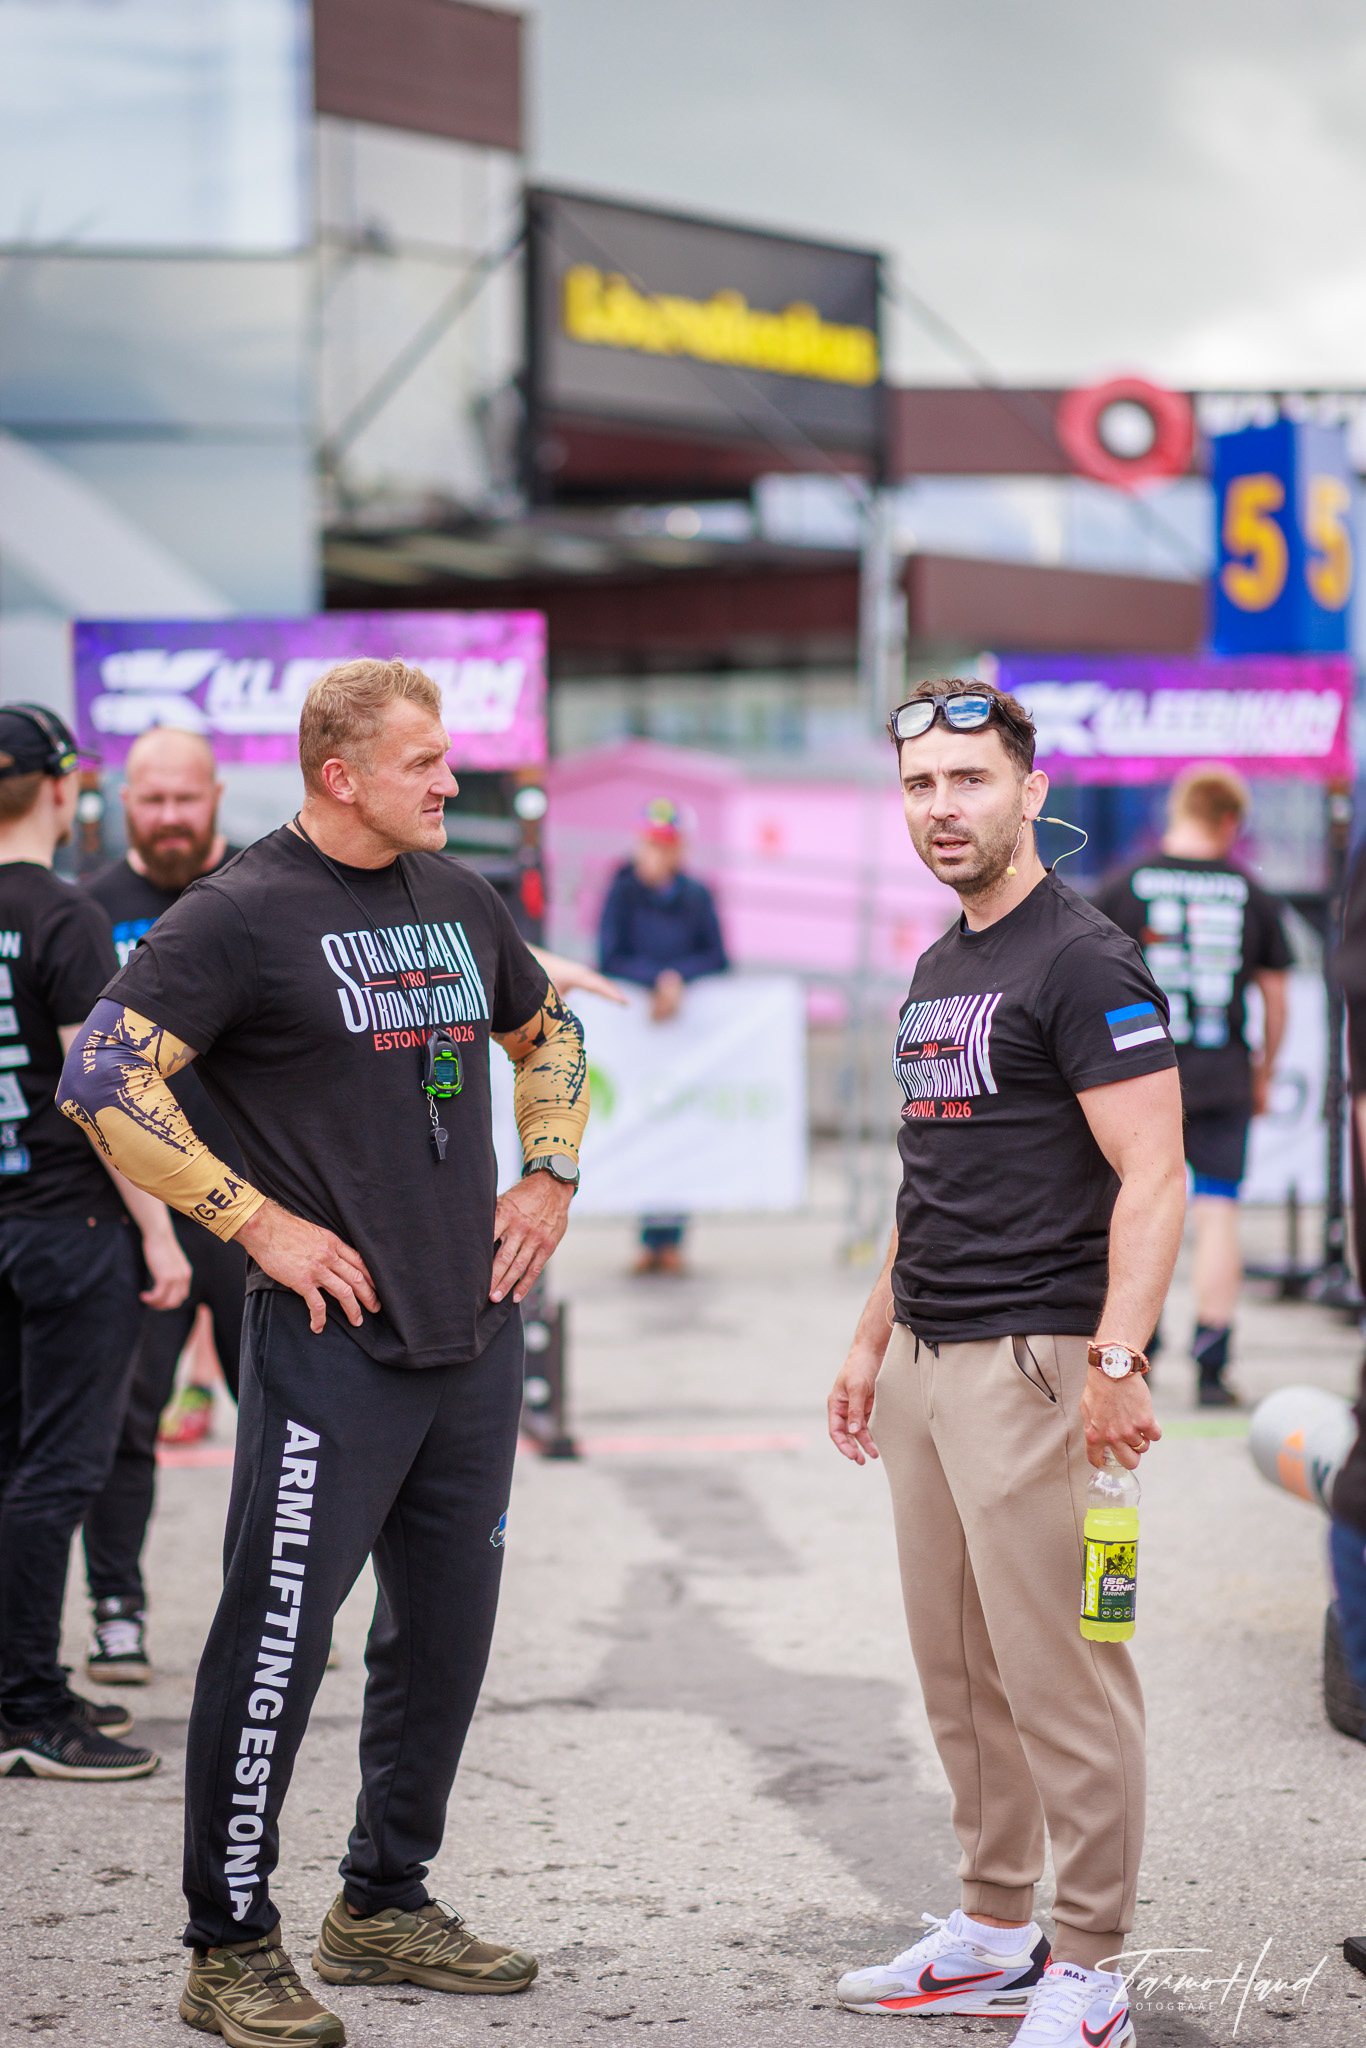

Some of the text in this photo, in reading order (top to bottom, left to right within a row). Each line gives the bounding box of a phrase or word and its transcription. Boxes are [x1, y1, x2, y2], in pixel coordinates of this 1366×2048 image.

[1222, 474, 1287, 611] 5
[1306, 474, 1352, 610] 5
[321, 922, 478, 982] STRONGMAN
[400, 971, 426, 988] PRO
[373, 1029, 432, 1051] ESTONI
[920, 1042, 938, 1058] PRO
[941, 1101, 972, 1118] 2026
[1102, 1583, 1135, 1591] TONIC
[224, 1419, 320, 1921] ARMLIFTING ESTONIA
